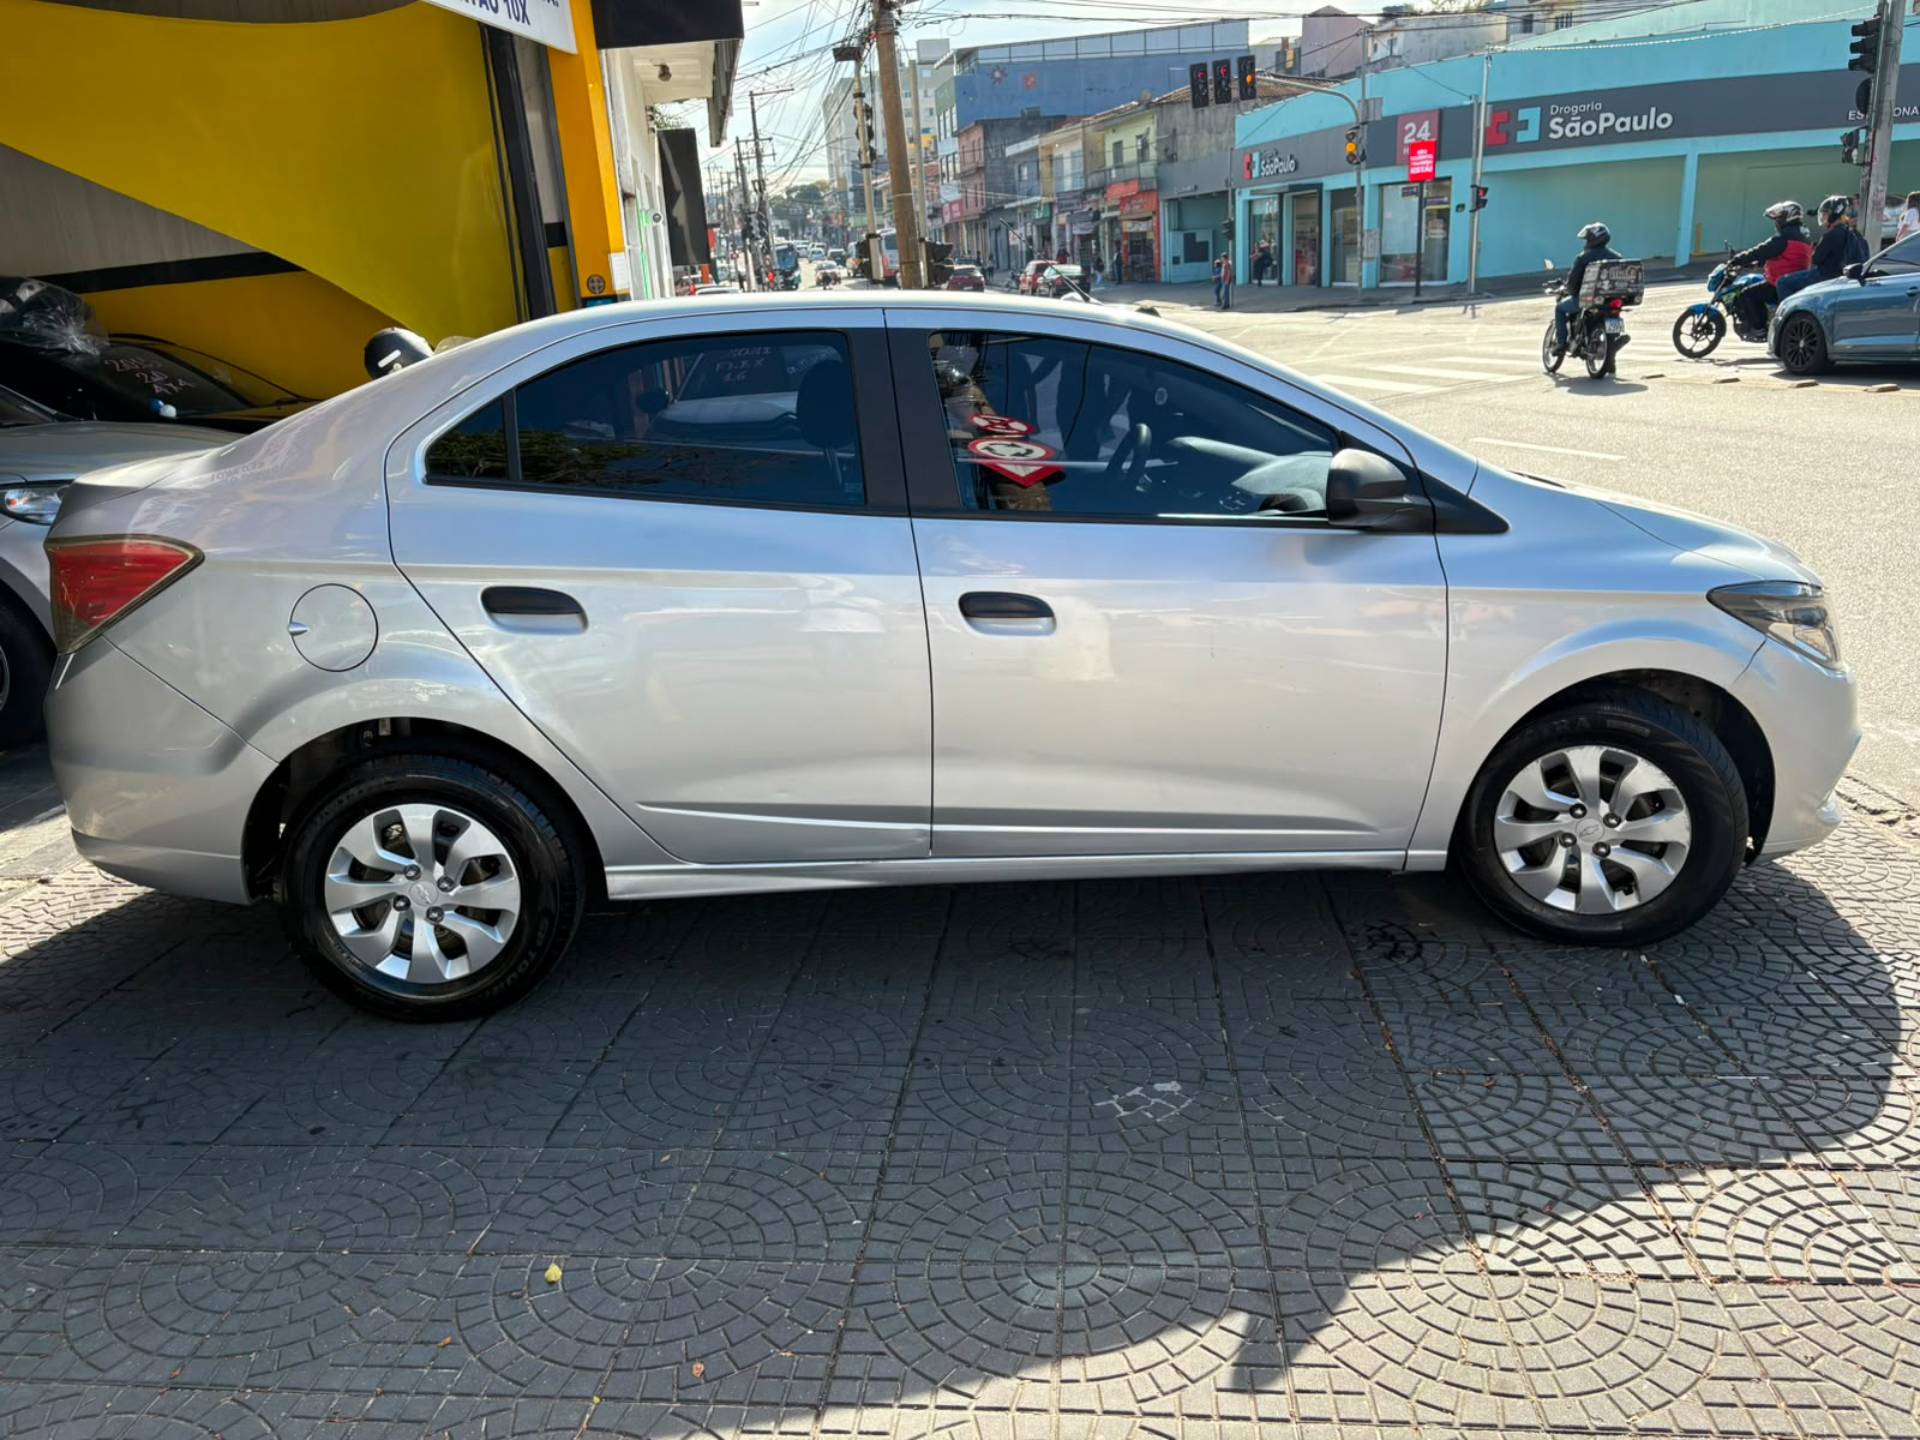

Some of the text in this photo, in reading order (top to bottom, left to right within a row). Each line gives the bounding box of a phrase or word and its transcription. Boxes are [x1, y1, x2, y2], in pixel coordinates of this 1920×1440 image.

[1550, 102, 1602, 116] Drogaria
[1403, 121, 1431, 144] 24
[1548, 107, 1673, 139] SãoPaulo
